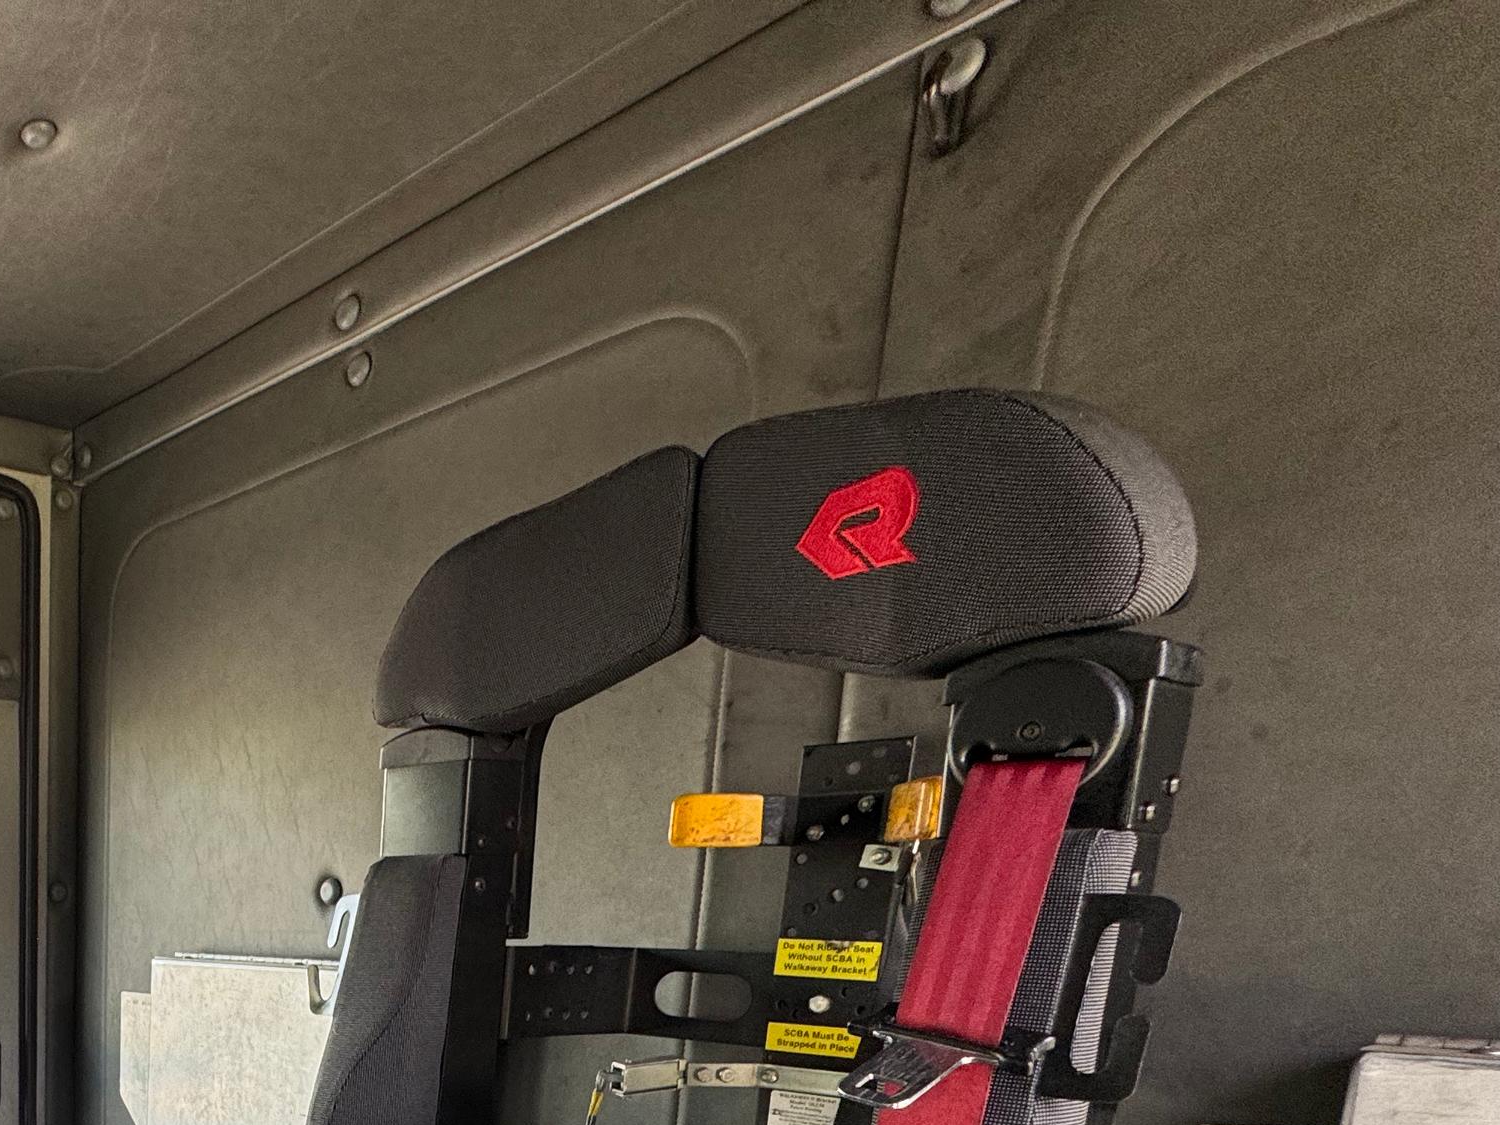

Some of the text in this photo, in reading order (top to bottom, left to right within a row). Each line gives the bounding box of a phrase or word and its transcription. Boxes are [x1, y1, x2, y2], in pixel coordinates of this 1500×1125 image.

[783, 941, 795, 950] Do
[798, 943, 815, 951] Not
[853, 945, 875, 953] Seat
[788, 952, 866, 964] Without SCBA in
[784, 963, 867, 975] Walkaway Bracket
[784, 1029, 850, 1041] SCBA Must Be
[777, 1038, 855, 1053] Strapped in Place
